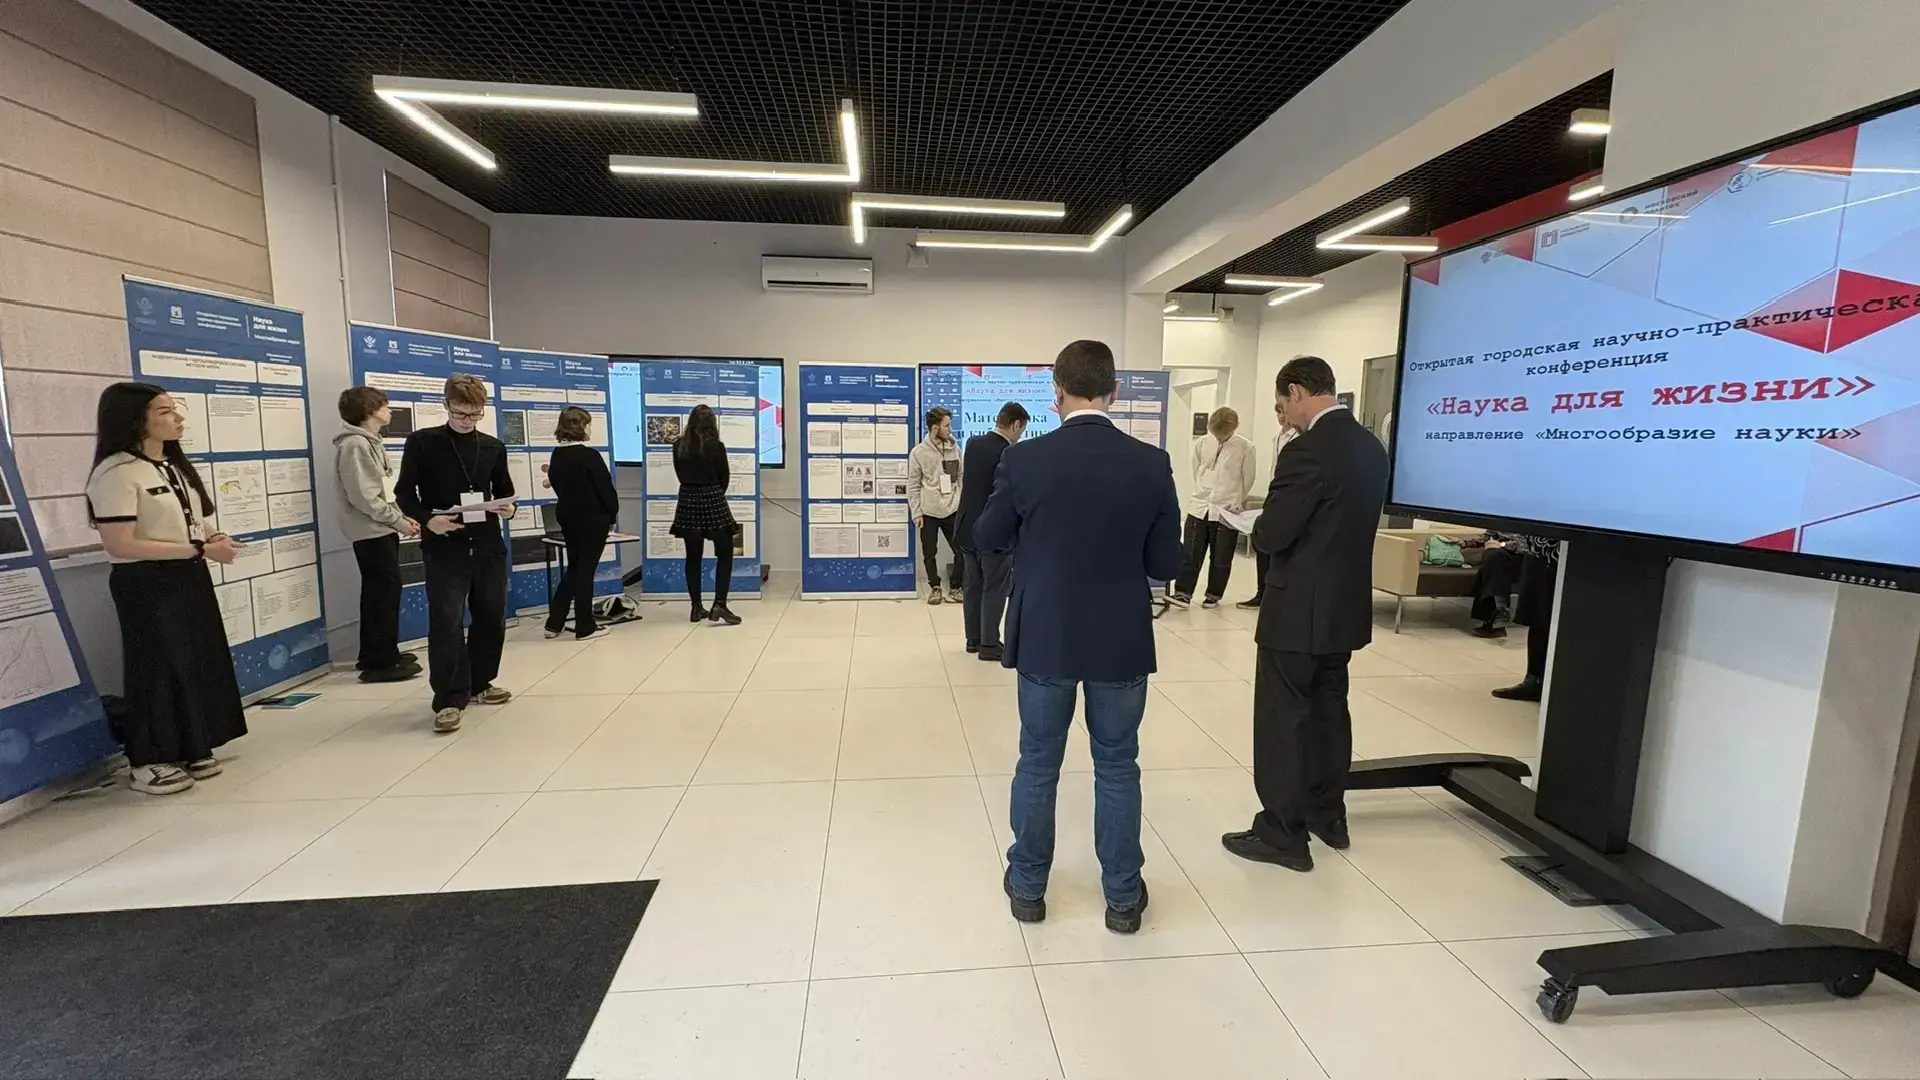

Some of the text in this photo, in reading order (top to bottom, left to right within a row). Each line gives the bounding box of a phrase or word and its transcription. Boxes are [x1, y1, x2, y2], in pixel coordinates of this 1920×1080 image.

[253, 316, 273, 325] Наука
[1409, 354, 1474, 372] Открытая
[1483, 340, 1580, 362] городская
[1525, 351, 1669, 375] конференция
[1426, 375, 1876, 417] «Наука для жизни»
[1425, 426, 1861, 443] направление «Многообразие науки»
